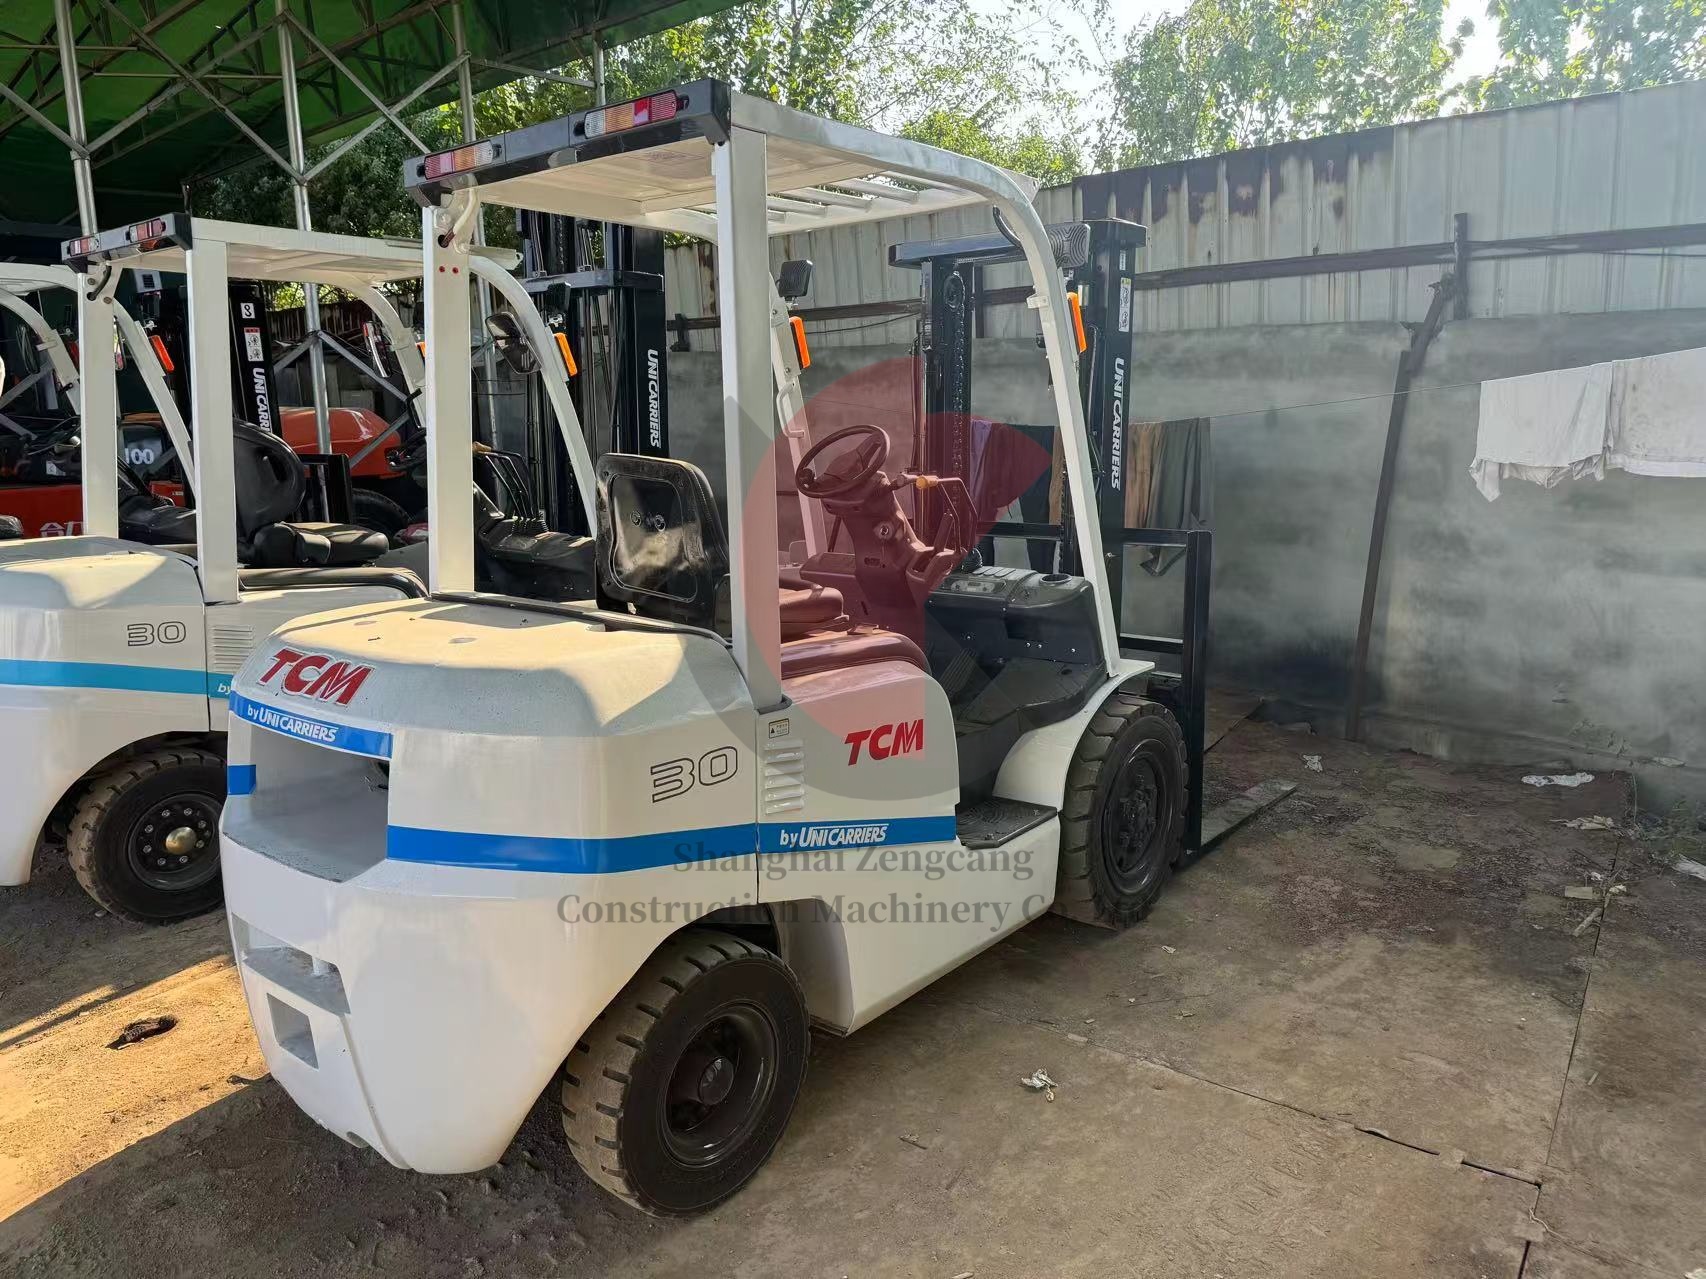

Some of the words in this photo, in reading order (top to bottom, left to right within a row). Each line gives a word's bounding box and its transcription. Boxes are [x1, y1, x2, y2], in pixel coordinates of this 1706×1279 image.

[647, 349, 661, 448] UNICARRIERS
[1111, 358, 1125, 490] UNICARRIERS
[127, 621, 187, 646] 30
[258, 647, 373, 706] TCM
[247, 705, 259, 722] by
[258, 707, 338, 743] UNICARRIERS
[844, 718, 924, 766] TCM
[650, 745, 739, 804] 30
[779, 829, 797, 848] by
[798, 823, 889, 848] UNICARRIERS
